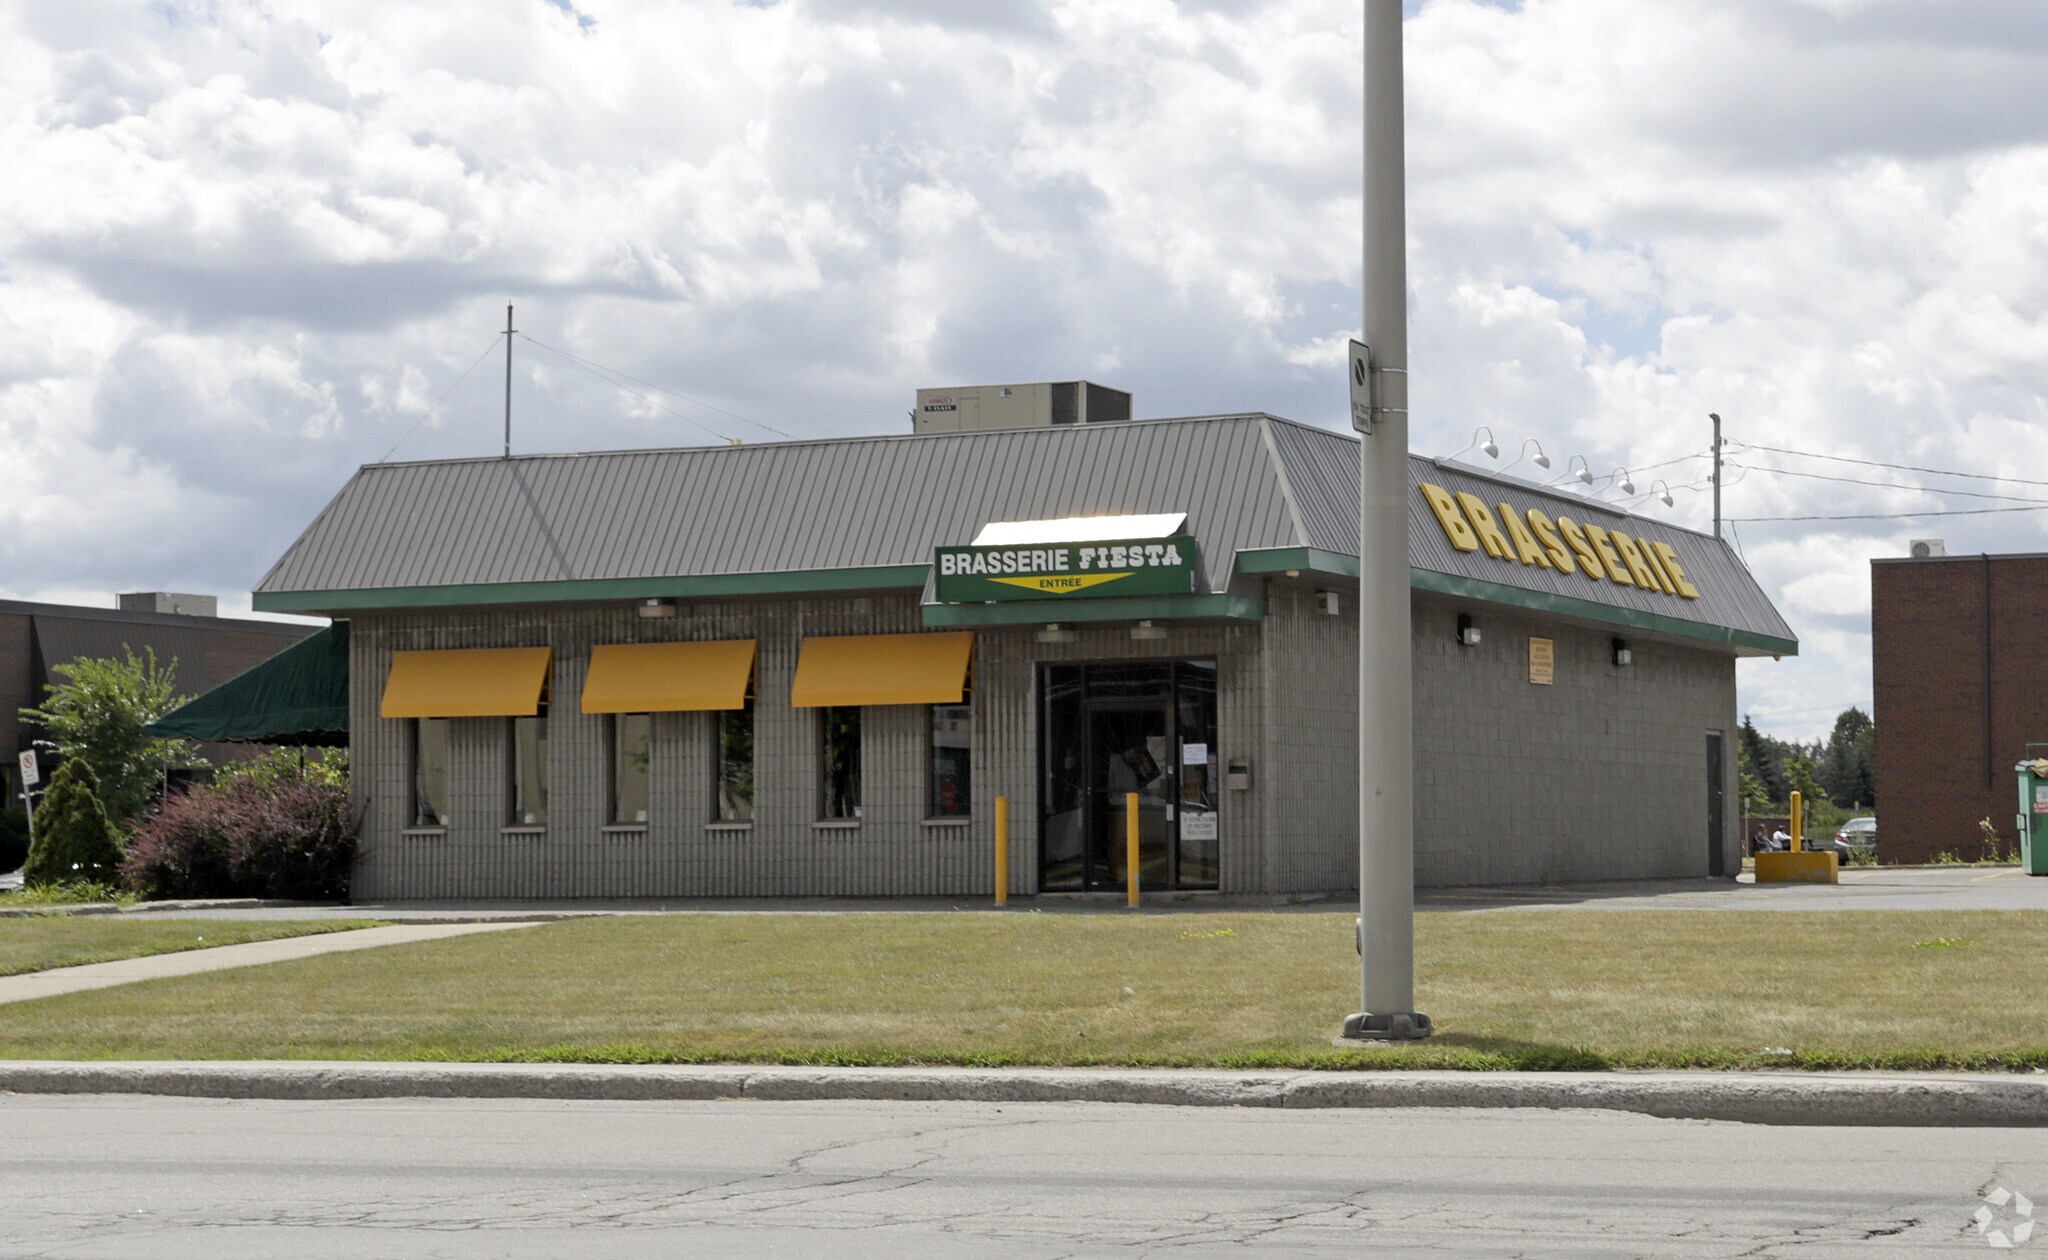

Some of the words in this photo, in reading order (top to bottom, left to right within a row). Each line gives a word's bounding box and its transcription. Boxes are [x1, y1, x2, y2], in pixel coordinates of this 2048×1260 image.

[1420, 482, 1700, 600] BRASSERIE
[941, 549, 1069, 575] BRASSERIE
[1079, 544, 1182, 569] FIESTA
[1040, 575, 1082, 588] ENTRÉE
